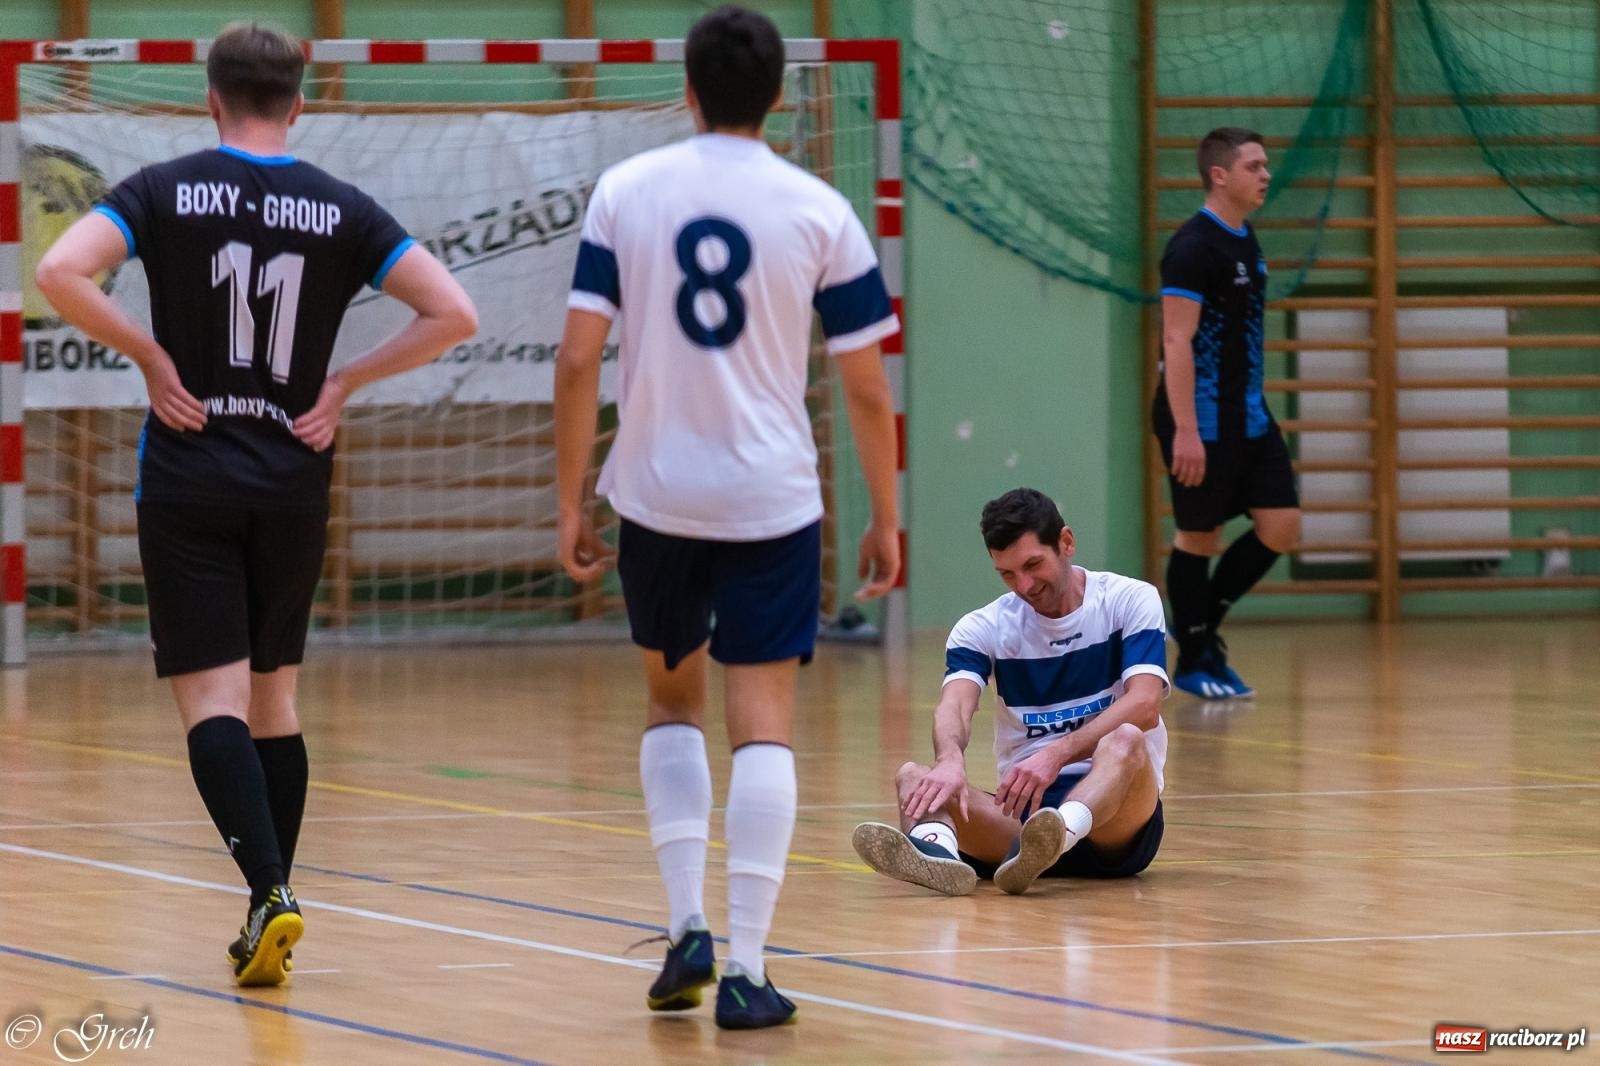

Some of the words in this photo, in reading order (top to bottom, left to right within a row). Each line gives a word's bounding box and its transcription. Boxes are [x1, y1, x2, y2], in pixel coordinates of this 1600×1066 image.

[176, 182, 240, 217] BOXY
[263, 195, 341, 236] GROUP
[212, 240, 305, 385] 11
[674, 215, 752, 349] 8
